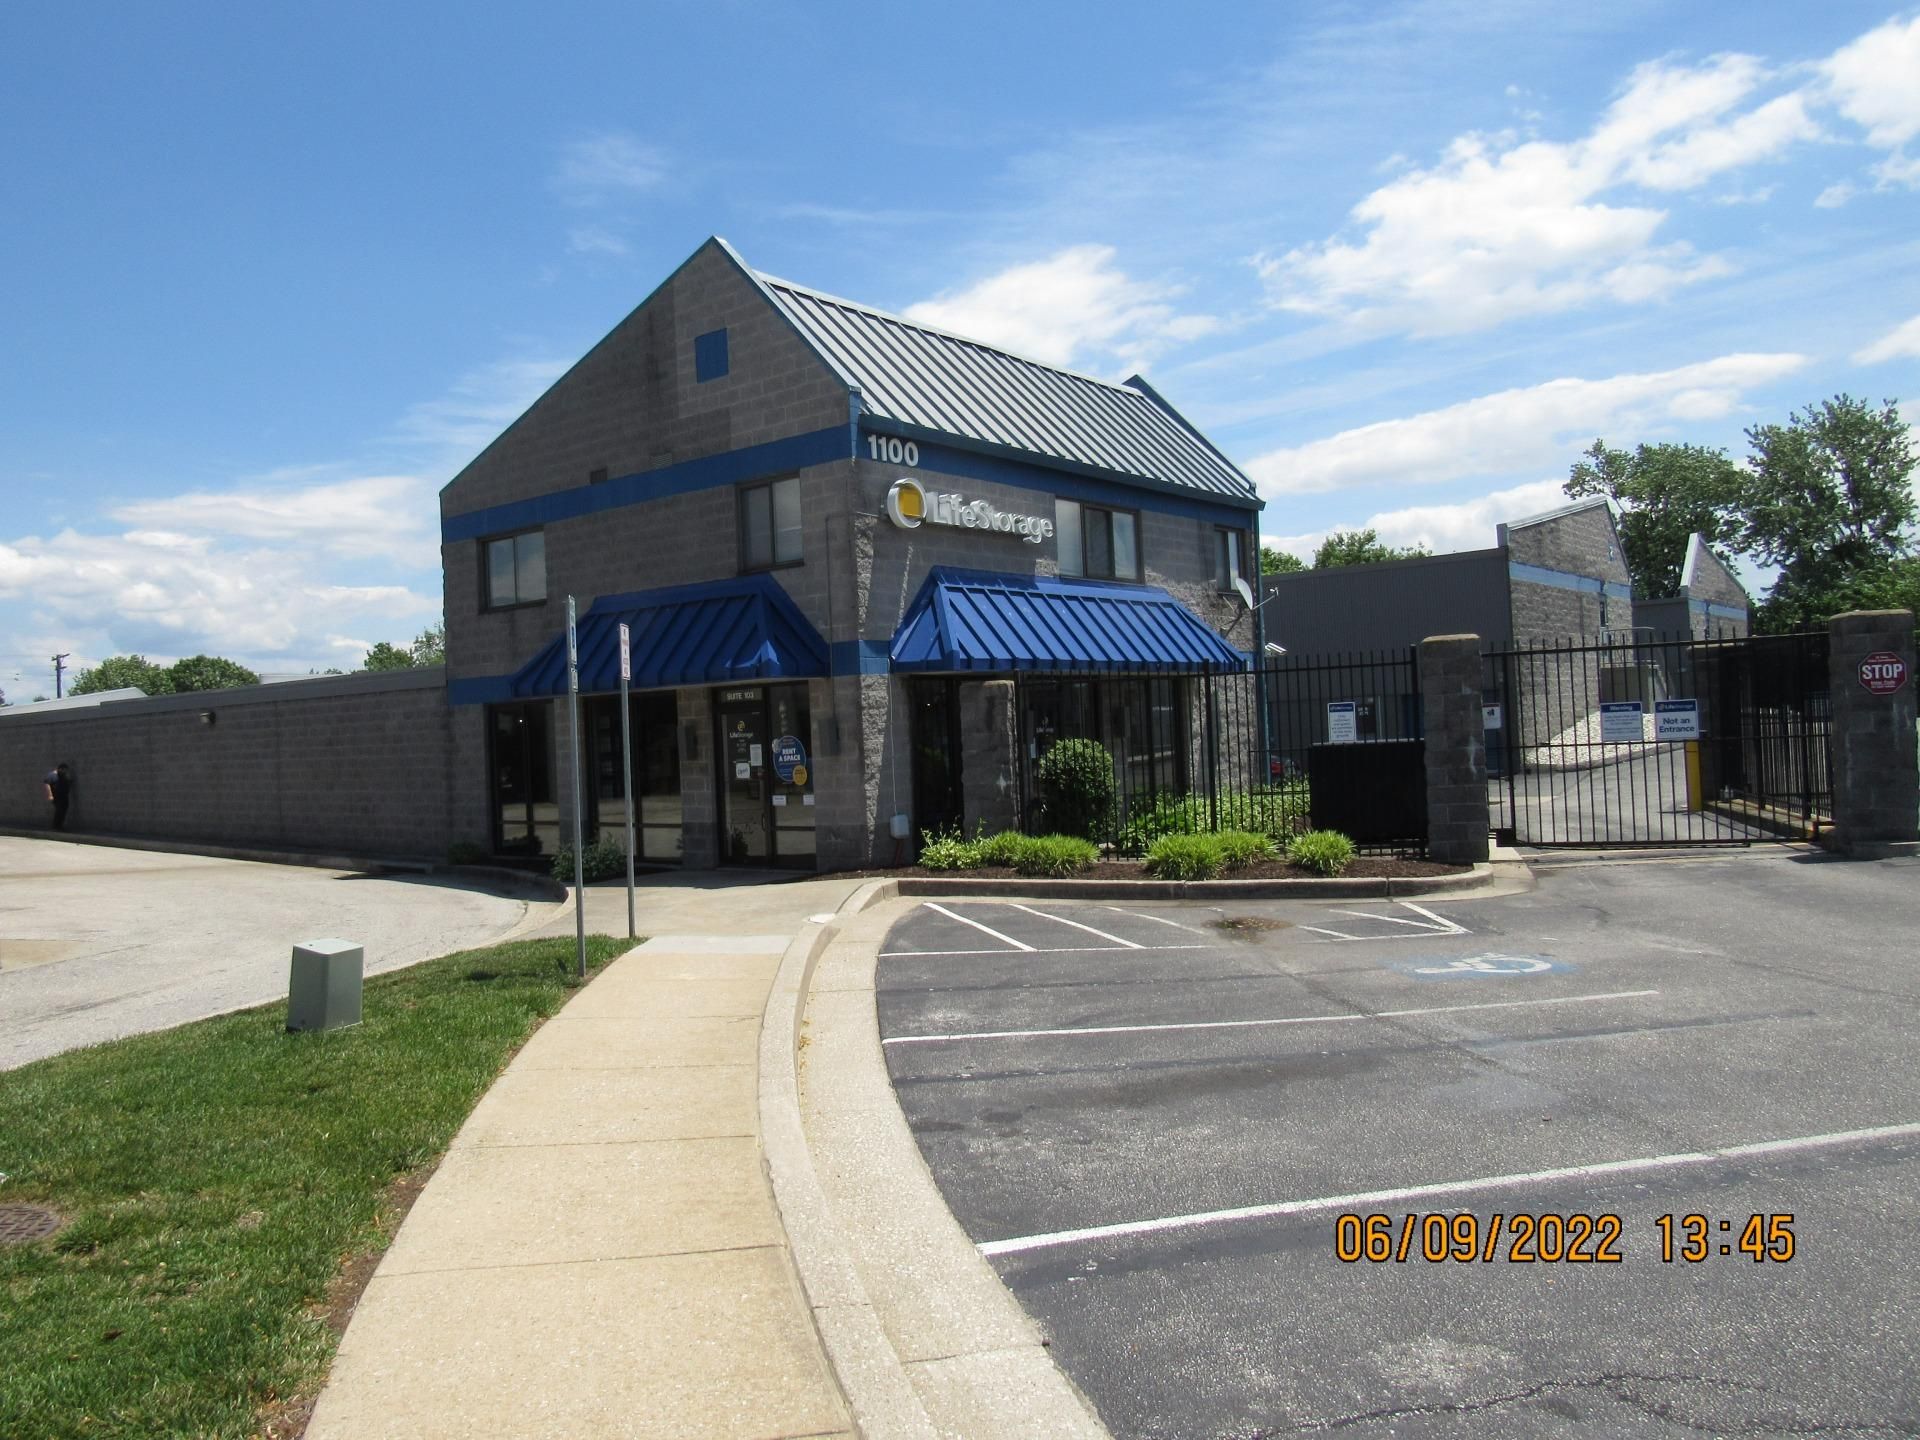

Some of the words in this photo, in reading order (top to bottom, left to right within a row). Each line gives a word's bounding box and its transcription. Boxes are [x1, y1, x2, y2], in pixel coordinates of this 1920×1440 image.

[868, 434, 919, 467] 1100
[926, 491, 1054, 544] LifeStorage
[1861, 663, 1903, 680] STOP
[727, 692, 743, 700] SUITE
[744, 691, 754, 699] 103
[1659, 725, 1695, 733] Entrance
[783, 754, 801, 762] SPACE
